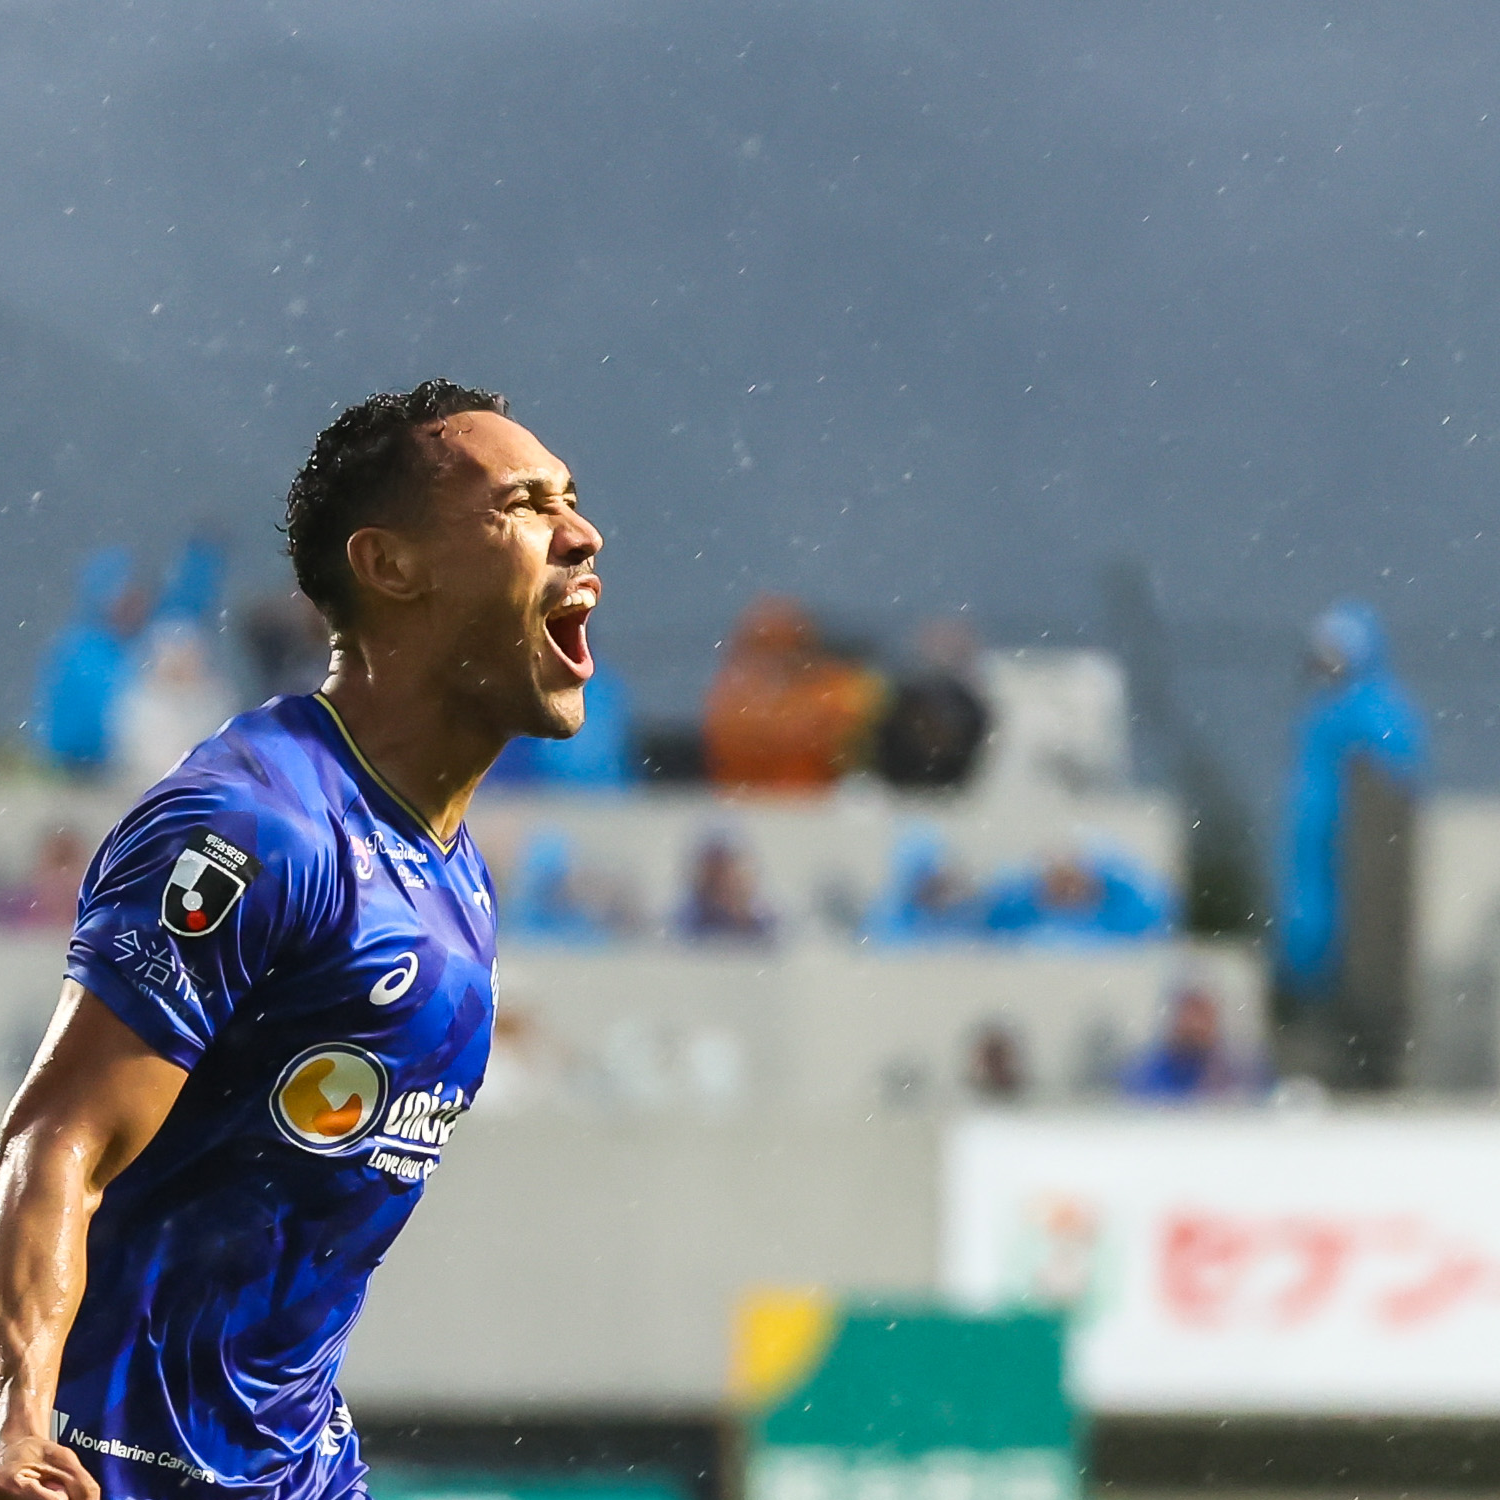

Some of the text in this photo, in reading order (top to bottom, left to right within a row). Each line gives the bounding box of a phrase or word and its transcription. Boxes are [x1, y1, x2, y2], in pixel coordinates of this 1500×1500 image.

[205, 833, 248, 866] 明治安田
[366, 1146, 399, 1175] Love
[157, 1451, 216, 1484] Carriers
